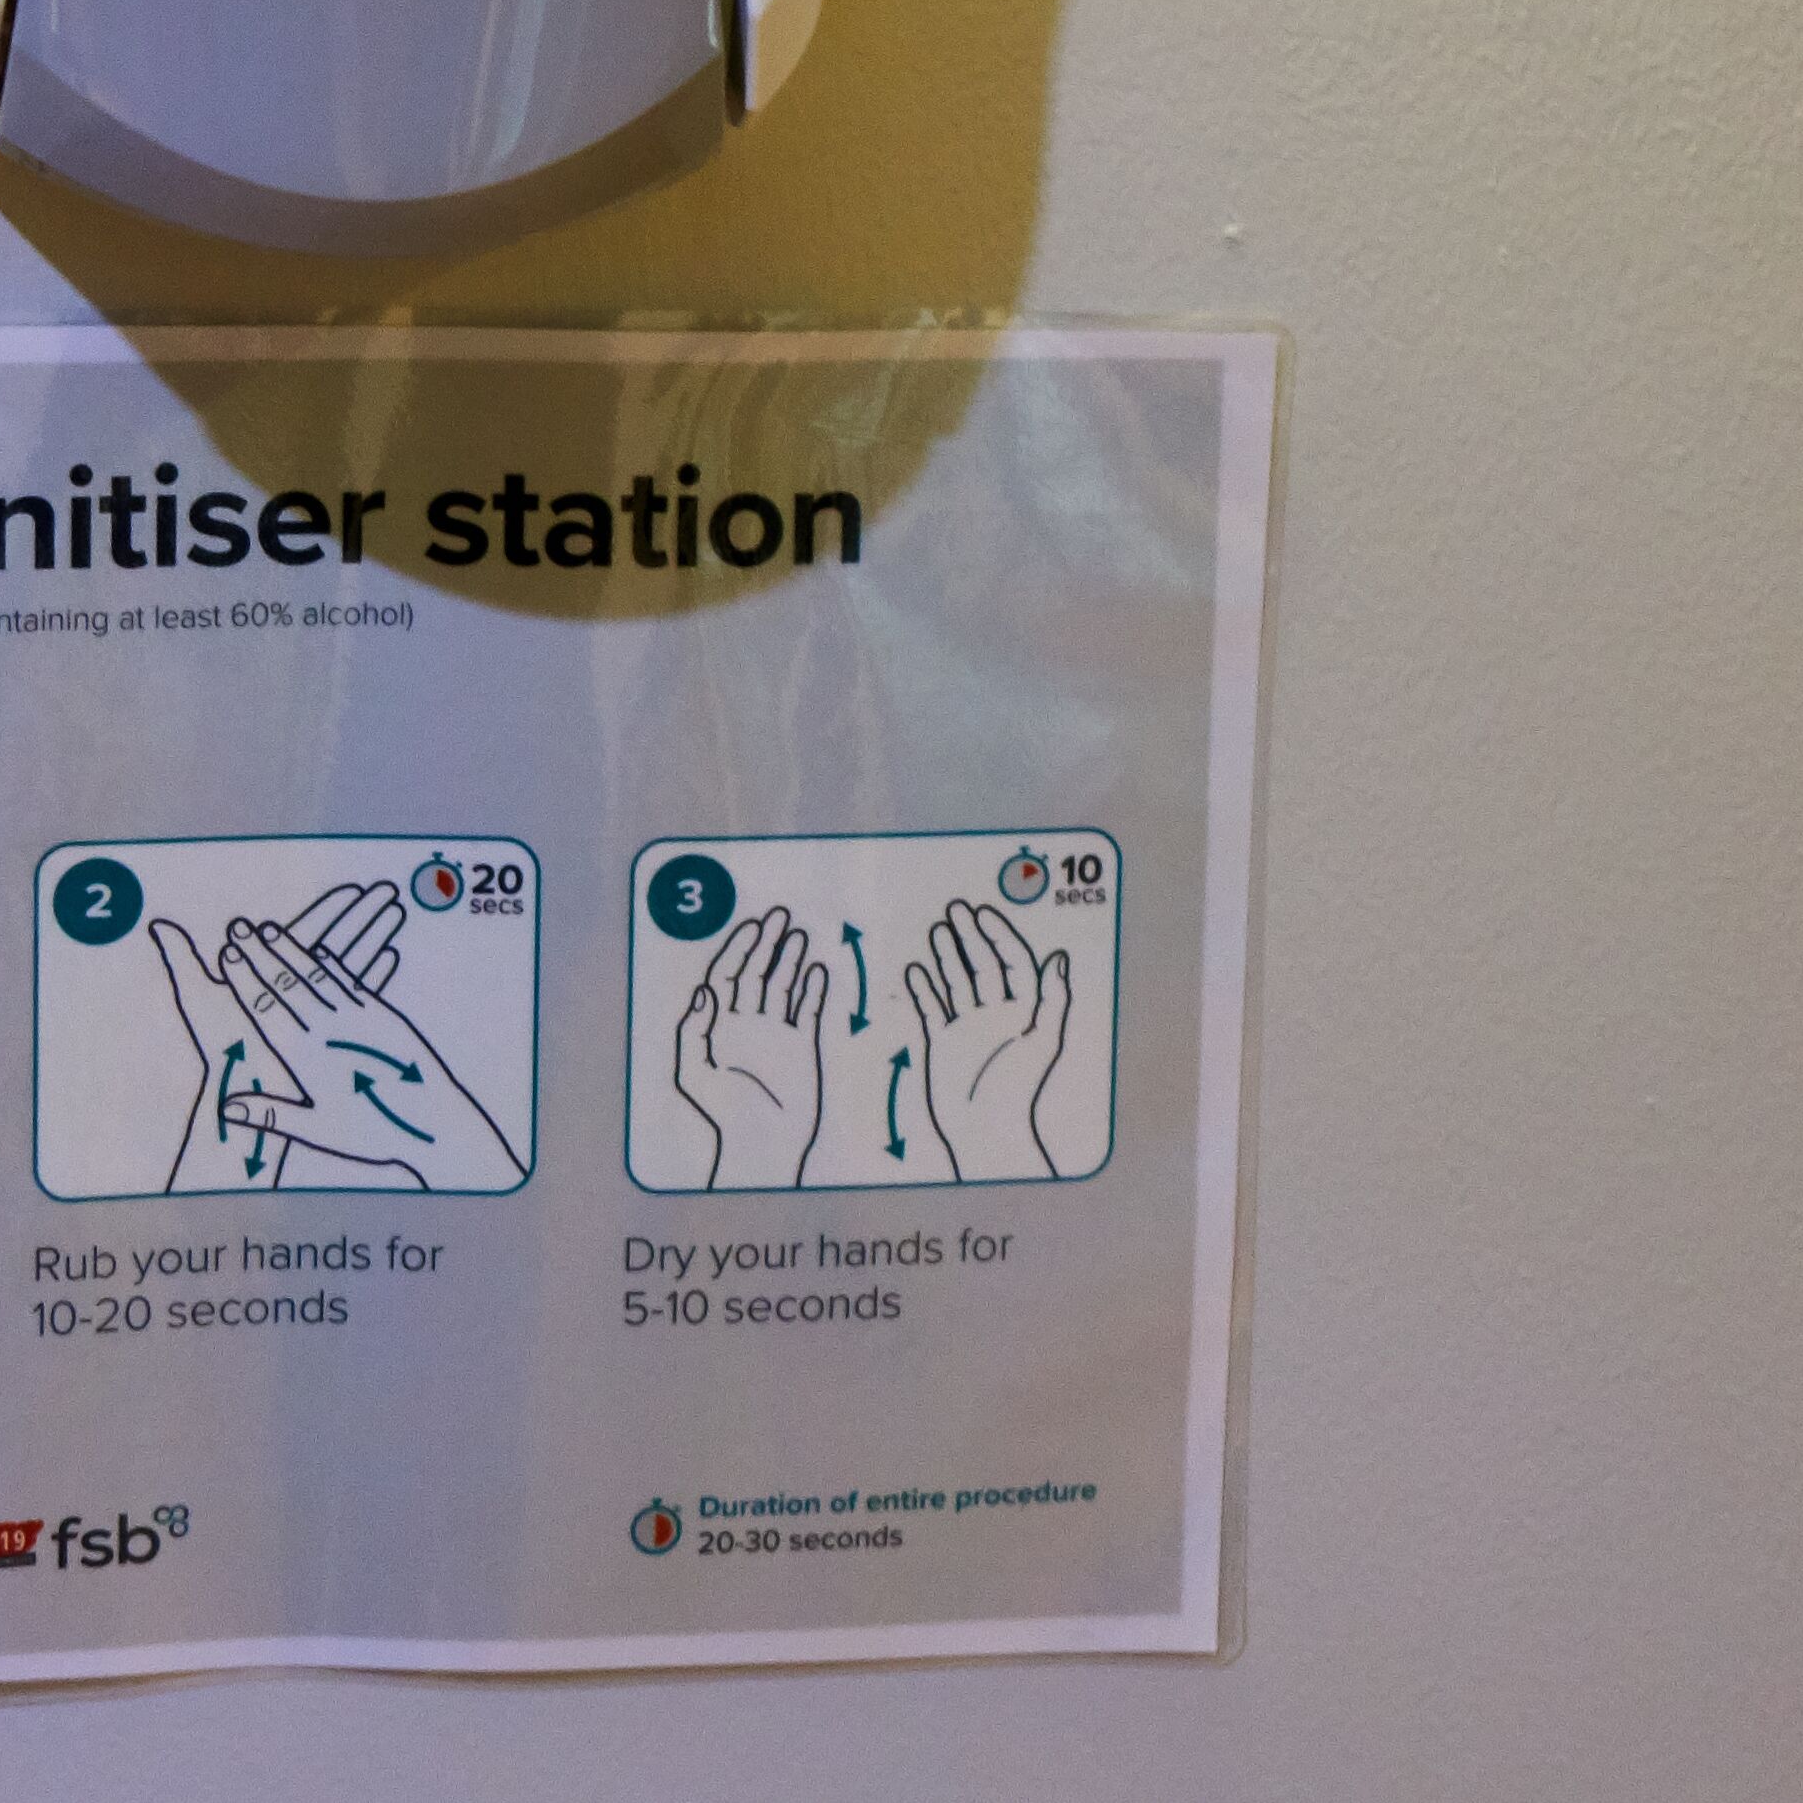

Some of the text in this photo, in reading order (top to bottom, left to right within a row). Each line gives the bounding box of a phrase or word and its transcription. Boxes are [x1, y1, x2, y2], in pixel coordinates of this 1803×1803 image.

[422, 461, 863, 569] station
[119, 604, 144, 632] at
[153, 601, 223, 632] least
[230, 599, 293, 630] 60%
[301, 597, 416, 633] alcohol)
[471, 863, 524, 896] 20
[1060, 854, 1103, 886] 10
[84, 884, 113, 919] 2
[469, 896, 525, 916] secs
[676, 879, 704, 913] 3
[1054, 886, 1107, 907] secs
[34, 1234, 444, 1285] Rub your hands for
[624, 1228, 1014, 1280] Dry your hands for
[31, 1289, 349, 1335] 10-20 seconds
[624, 1286, 901, 1326] 5-10 seconds
[699, 1480, 1096, 1519] Duration of entire procedure
[51, 1513, 161, 1569] fsb
[699, 1525, 902, 1555] 20-30 seconds
